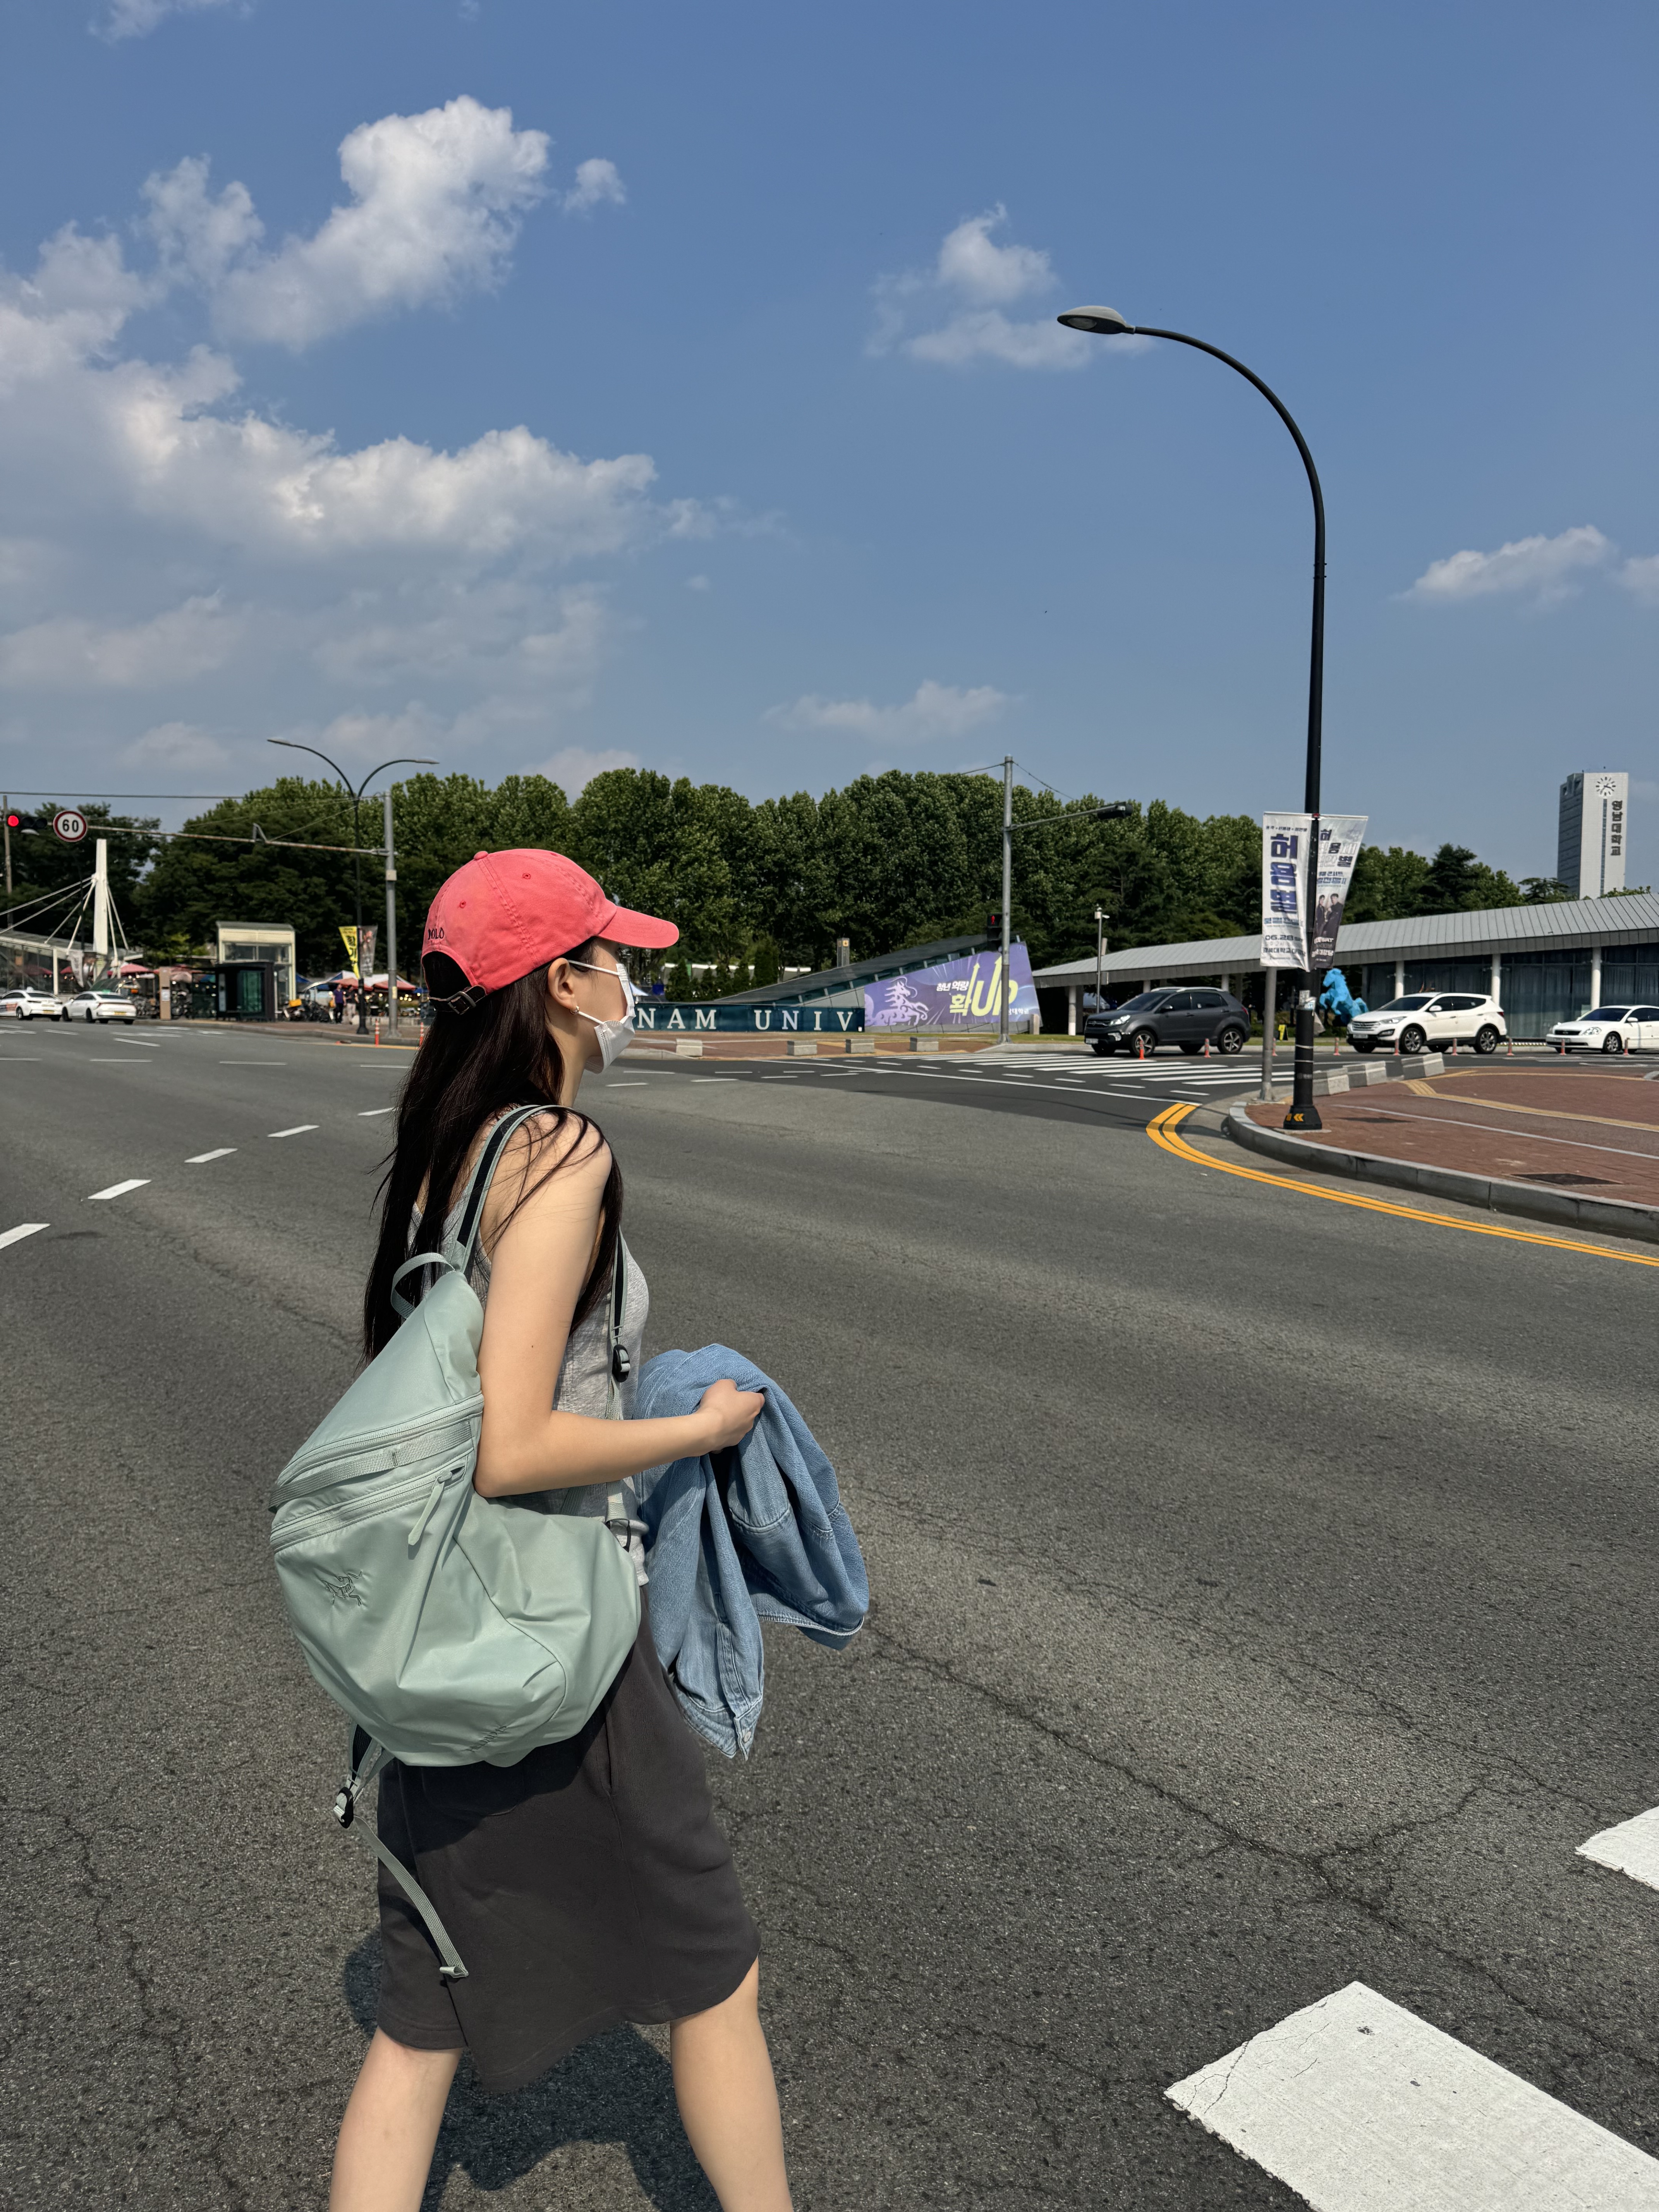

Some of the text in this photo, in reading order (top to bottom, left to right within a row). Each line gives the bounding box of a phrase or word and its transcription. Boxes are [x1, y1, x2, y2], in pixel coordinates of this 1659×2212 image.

[62, 819, 79, 832] 60
[428, 927, 444, 940] POLO
[936, 981, 969, 991] 청년 역량
[637, 1008, 853, 1031] NAM UNIV
